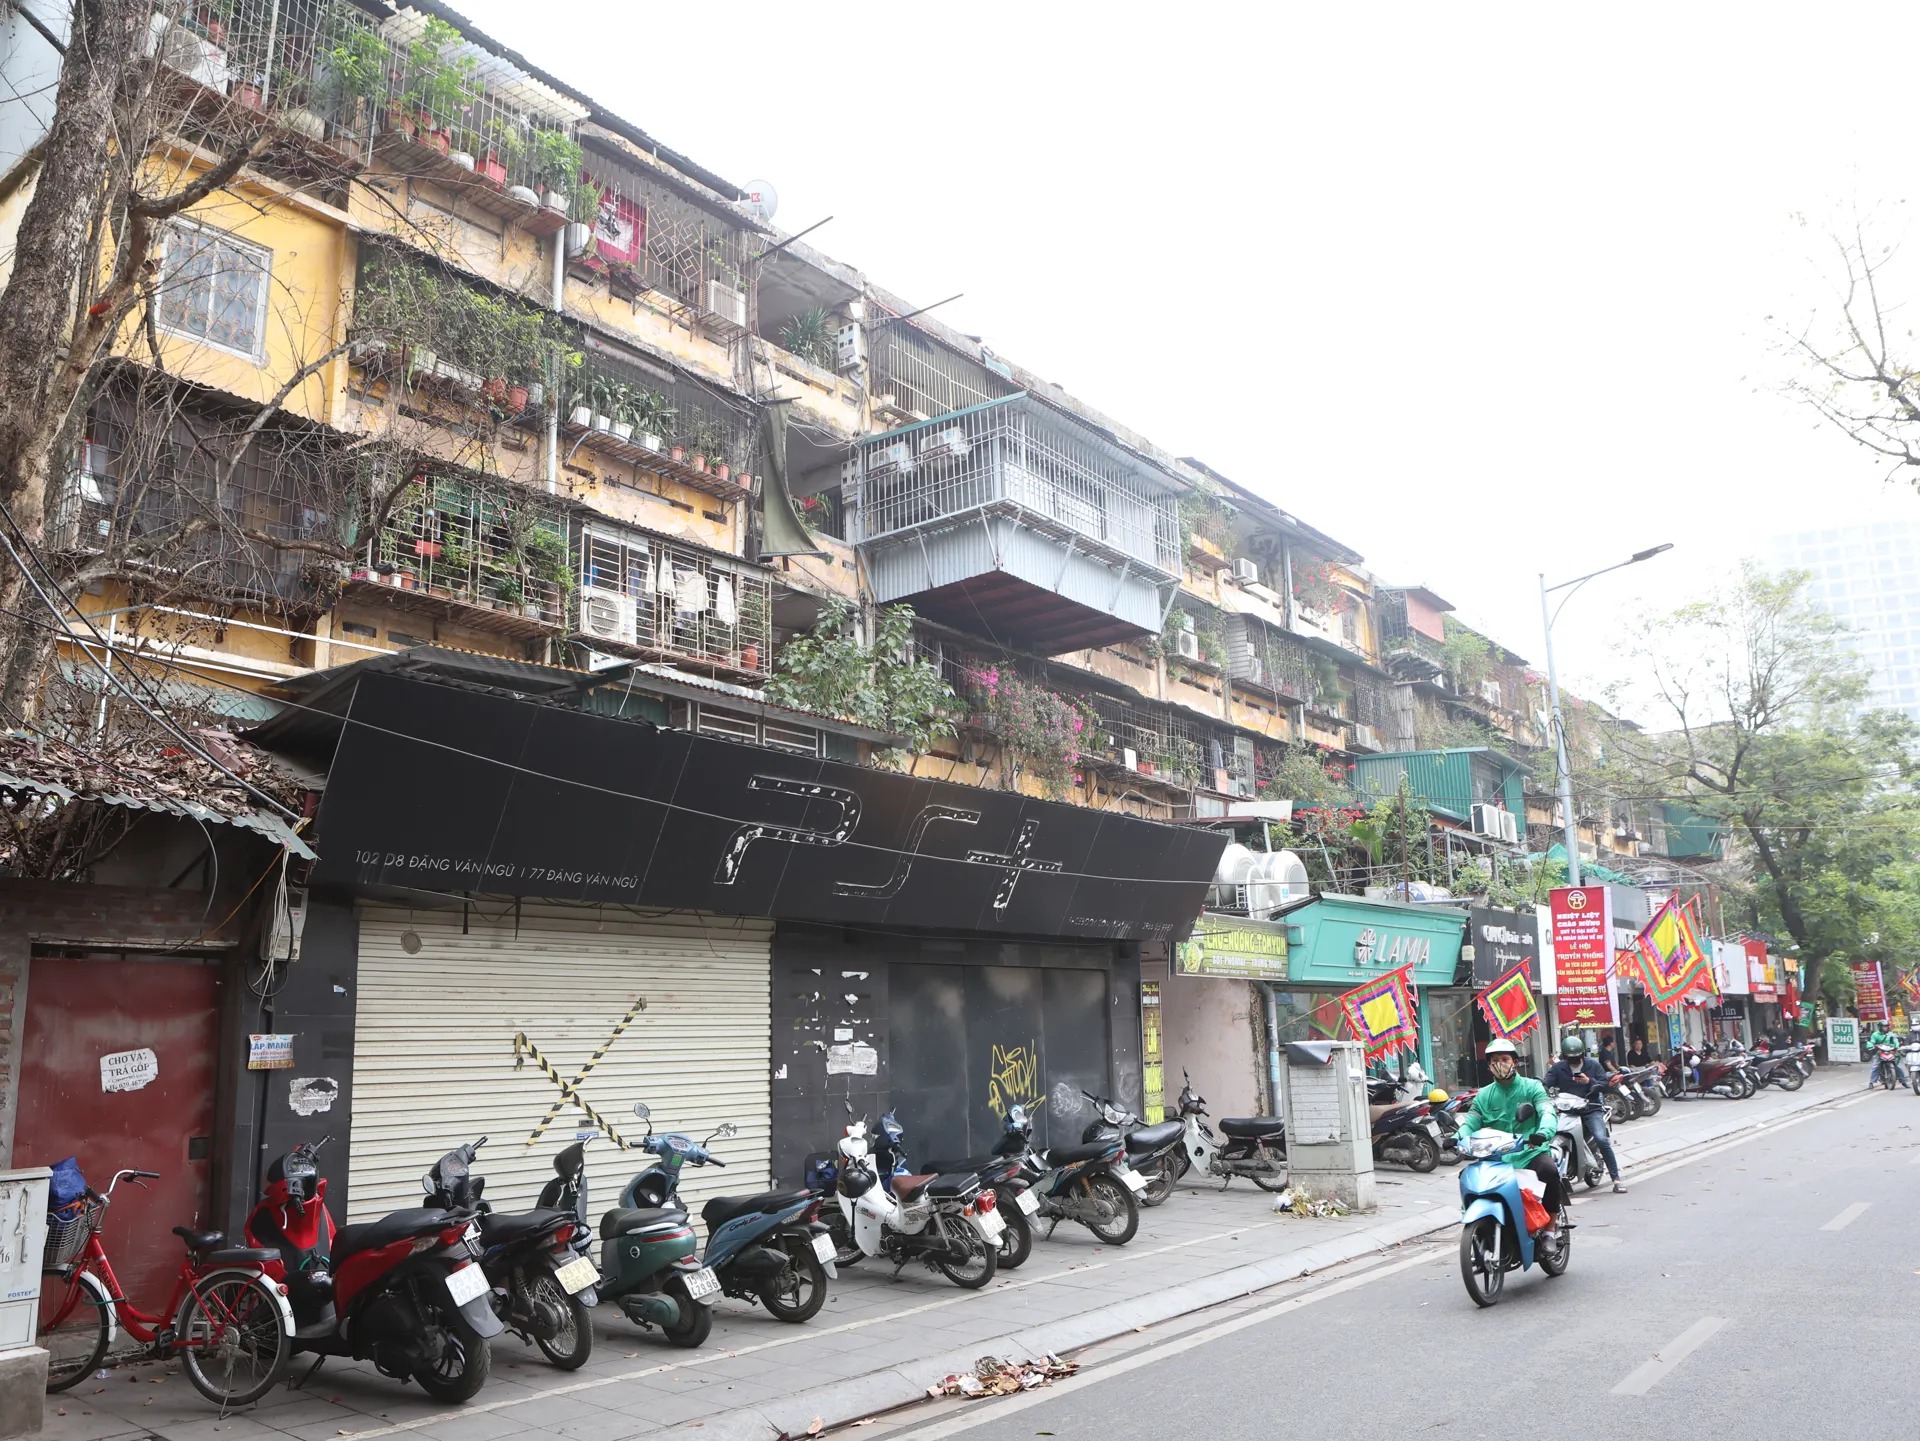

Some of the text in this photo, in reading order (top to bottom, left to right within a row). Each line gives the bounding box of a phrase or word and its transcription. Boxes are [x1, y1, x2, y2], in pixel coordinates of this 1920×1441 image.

[356, 850, 380, 864] 102
[384, 853, 405, 867] D8
[409, 854, 450, 871] ĐẶNG
[529, 867, 545, 879] 77
[1374, 934, 1431, 964] LAMA
[108, 1055, 129, 1066] CHO
[691, 1279, 719, 1298] 429.96
